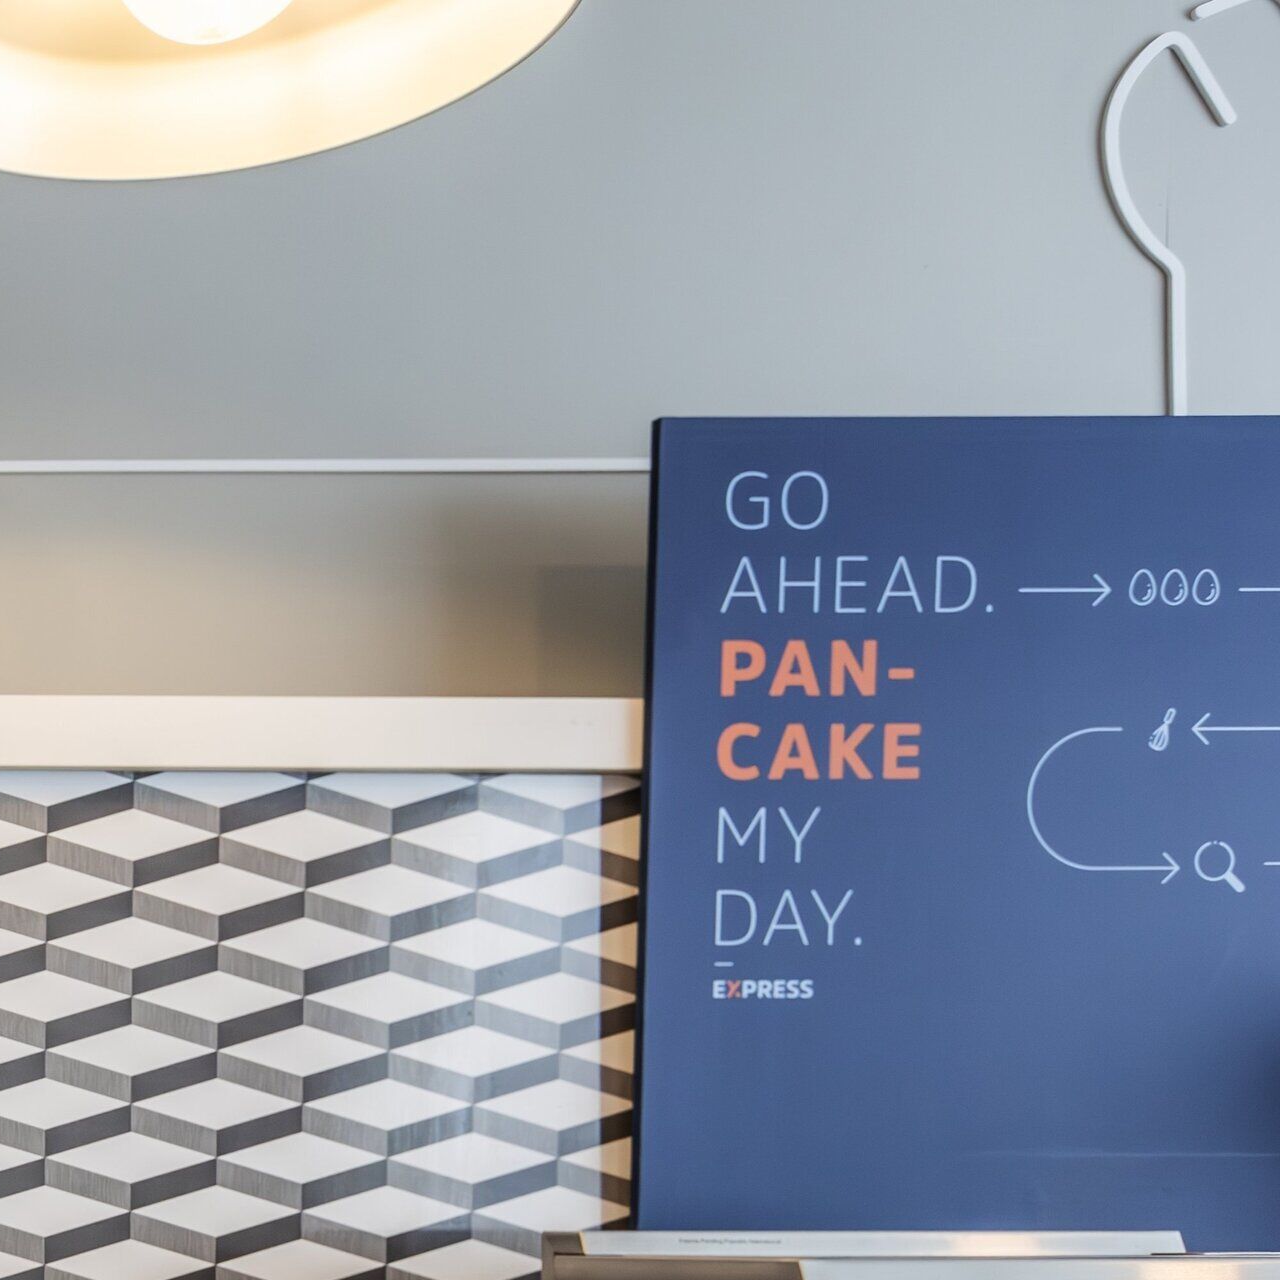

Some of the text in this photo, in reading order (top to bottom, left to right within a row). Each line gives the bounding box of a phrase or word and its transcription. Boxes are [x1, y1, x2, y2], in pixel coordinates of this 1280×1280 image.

[725, 470, 830, 531] GO
[720, 556, 995, 615] AHEAD.
[720, 639, 916, 697] PAN-
[716, 722, 922, 780] CAKE
[716, 807, 821, 864] MY
[713, 889, 863, 947] DAY.
[713, 979, 814, 1000] EXPRESS
